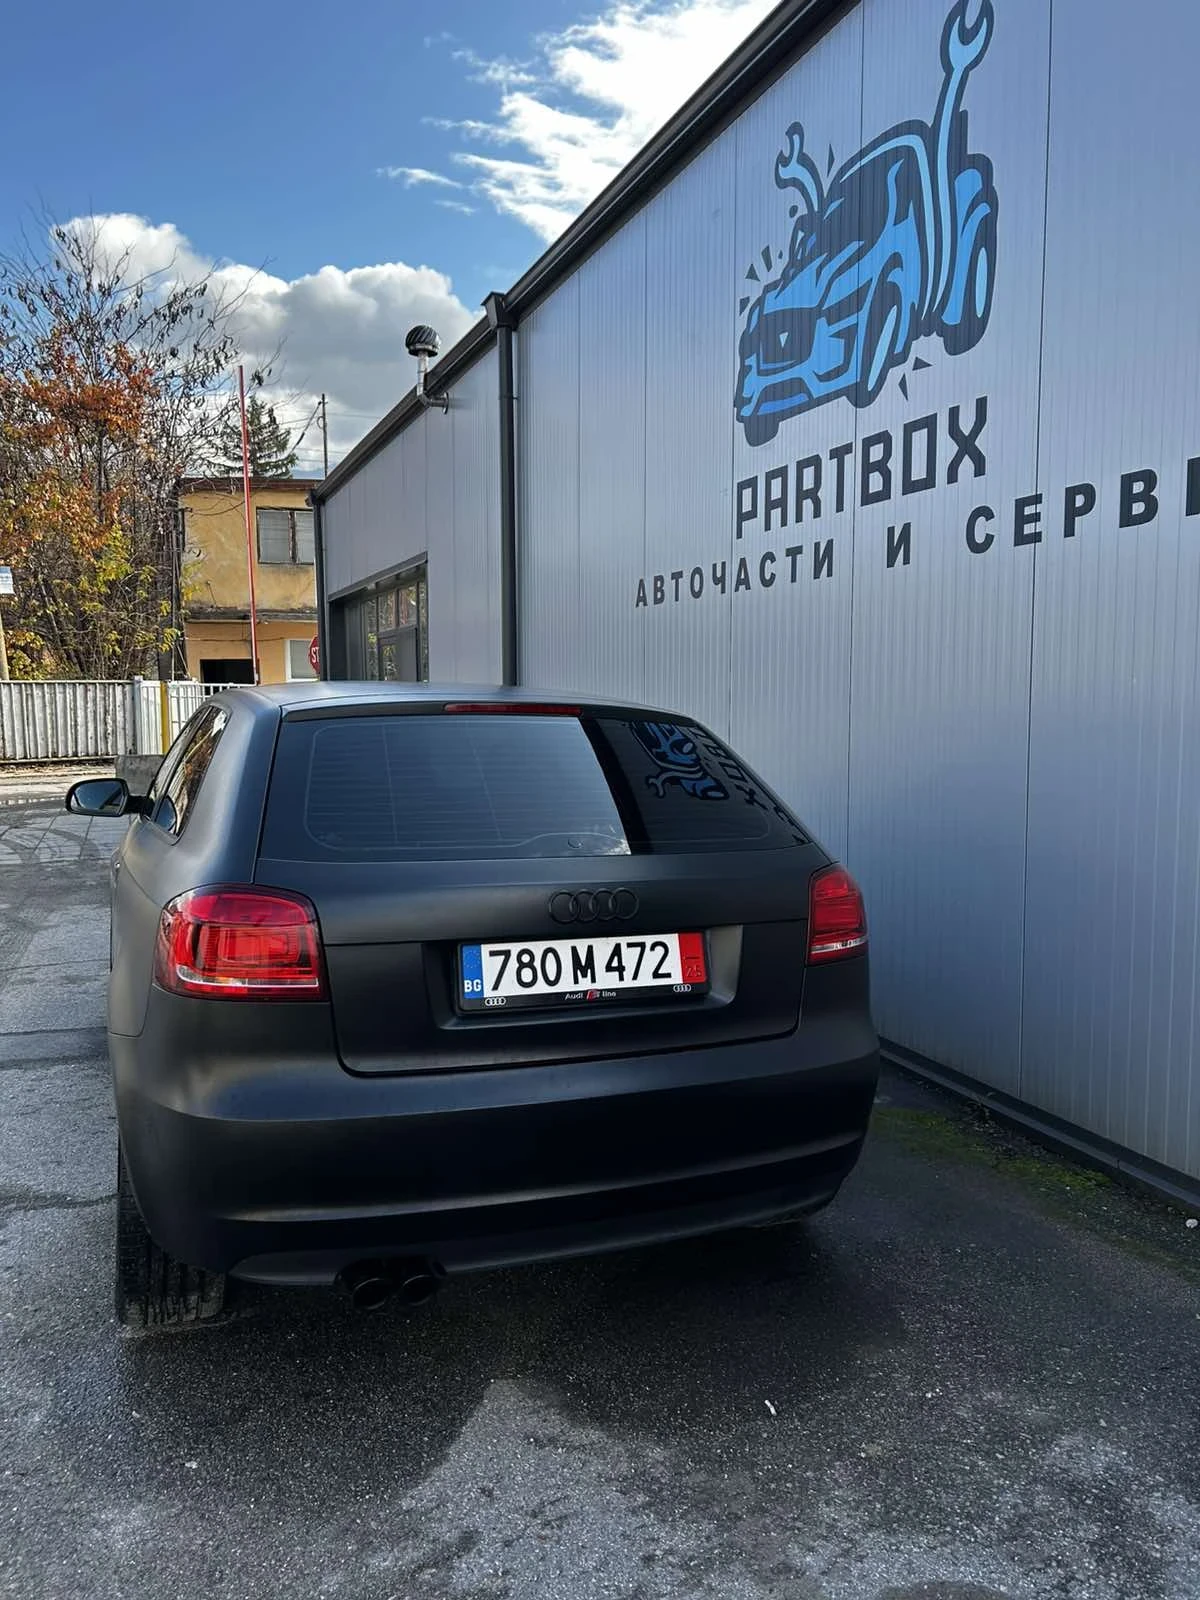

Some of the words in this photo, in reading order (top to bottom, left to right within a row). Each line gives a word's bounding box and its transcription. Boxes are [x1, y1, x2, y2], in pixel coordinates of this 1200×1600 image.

[736, 395, 988, 540] PARTBOX
[635, 538, 834, 608] АВТОЧАСТИ
[886, 522, 911, 568] И
[311, 646, 319, 663] ST
[464, 979, 482, 992] BG
[489, 946, 562, 991] 780
[570, 944, 597, 985] M
[604, 940, 672, 982] 472
[566, 992, 584, 1000] Audi
